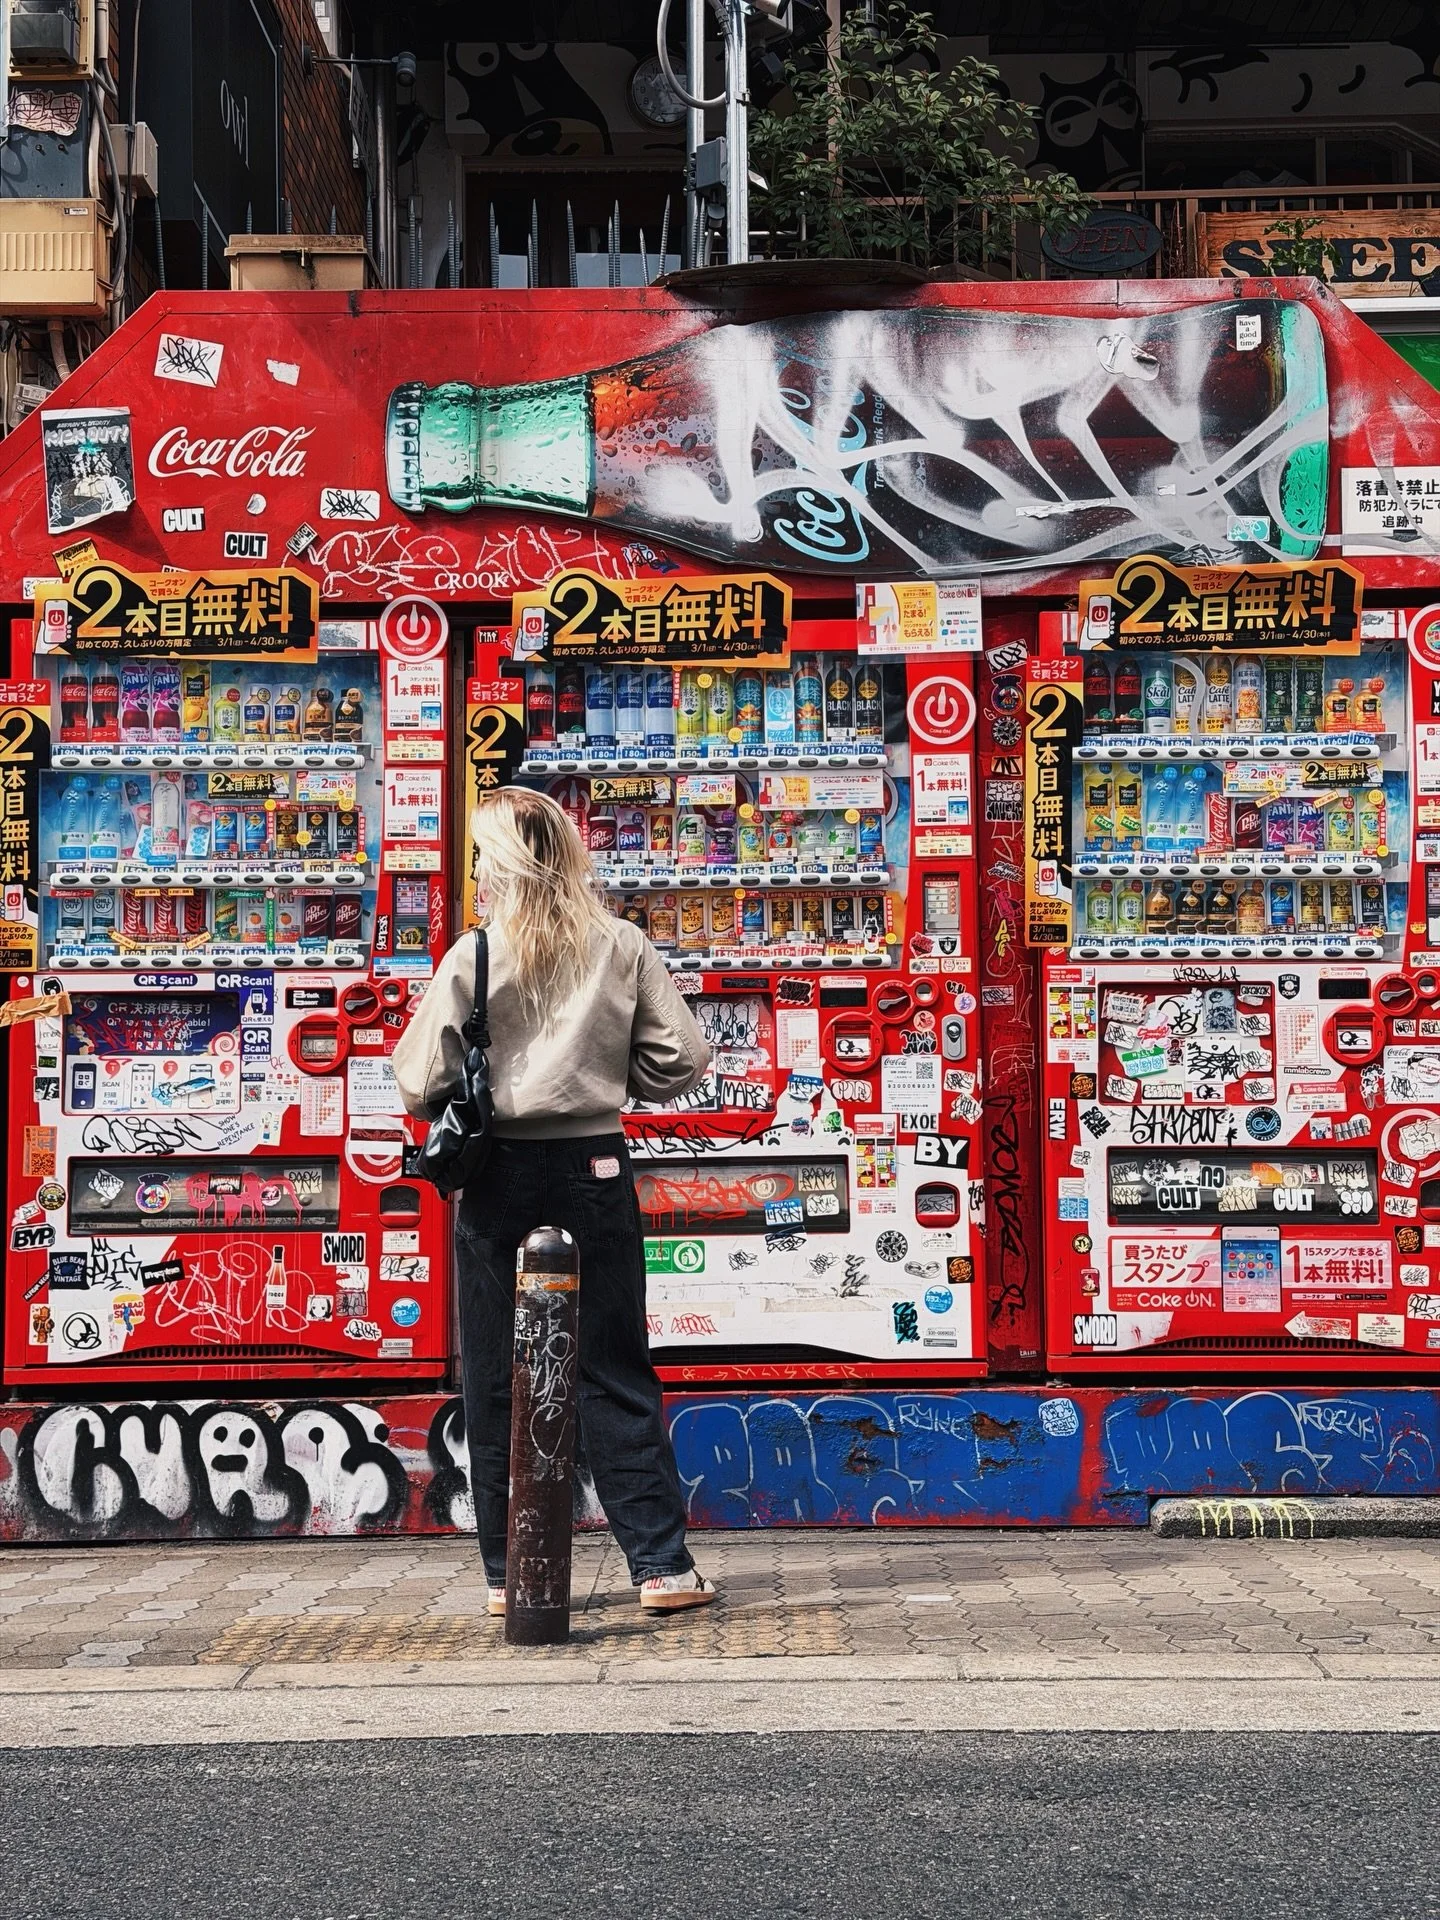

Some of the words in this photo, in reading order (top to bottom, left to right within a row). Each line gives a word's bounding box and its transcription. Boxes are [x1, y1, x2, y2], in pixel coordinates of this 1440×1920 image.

[1052, 226, 1150, 255] OPEN
[1239, 331, 1257, 339] good
[147, 426, 317, 478] Coca-Cola
[163, 508, 205, 533] CULT
[226, 534, 267, 557] CULT
[149, 578, 187, 587] コークオン
[435, 571, 509, 589] CROOK
[1192, 572, 1230, 582] コークオン
[150, 588, 181, 596] で買うと
[624, 585, 662, 594] コークオン
[1192, 581, 1223, 591] で買うと
[625, 594, 655, 603] で買うと
[939, 590, 956, 600] Coke
[1120, 565, 1335, 634] 2本目無料
[76, 569, 293, 638] 2本目無料
[553, 578, 766, 645] 2本目無料
[903, 608, 926, 618] たまる!
[903, 628, 933, 638] もらえる!
[1119, 633, 1234, 645] 初めての方、久しぶりの方限定
[76, 638, 192, 650] 初めての方、久しぶりの方限定
[553, 644, 666, 656] 初めての方、久しぶりの方限定
[1031, 660, 1078, 669] コークオン
[122, 674, 148, 684] FANTA
[153, 674, 180, 684] FANTA
[1031, 669, 1069, 680] で買うと
[390, 674, 441, 697] 1本無料!
[471, 681, 519, 691] コークオン
[472, 691, 508, 700] で買うと
[1208, 694, 1230, 703] LATTE
[827, 700, 850, 710] BLACK
[856, 700, 881, 710] BLACK
[1030, 686, 1066, 857] 2本目無料
[1304, 761, 1366, 782] 2本目無料
[211, 772, 272, 793] 2本目無料
[917, 769, 968, 792] 1本無料!
[388, 784, 438, 806] 1本無料!
[594, 779, 653, 800] 2本目無料
[1030, 908, 1068, 916] 久しぶりの方
[138, 975, 157, 986] QR
[160, 976, 193, 985] Scan!
[216, 974, 242, 988] QR
[242, 975, 272, 986] Scan!
[243, 1030, 269, 1044] QR
[243, 1044, 270, 1052] Scan!
[218, 1114, 236, 1128] SHOW
[901, 1114, 937, 1130] EXOE
[1079, 1111, 1102, 1140] FREE
[1091, 1105, 1112, 1132] SOUL
[216, 1123, 255, 1148] REPENTANCE
[916, 1136, 968, 1165] BY
[1158, 1186, 1198, 1210] CULT
[1273, 1188, 1315, 1212] CULT
[324, 1235, 364, 1263] SWORD
[1124, 1244, 1188, 1260] 買うたび
[1304, 1247, 1384, 1257] 15スタンプたまると
[52, 1256, 68, 1266] BLUE
[69, 1256, 86, 1265] BEAN
[1286, 1244, 1384, 1284] 1本無料!
[53, 1274, 82, 1282] VINTAGE
[1123, 1260, 1210, 1284] スタンプ
[1137, 1292, 1182, 1308] Coke
[1074, 1315, 1116, 1344] SWORD
